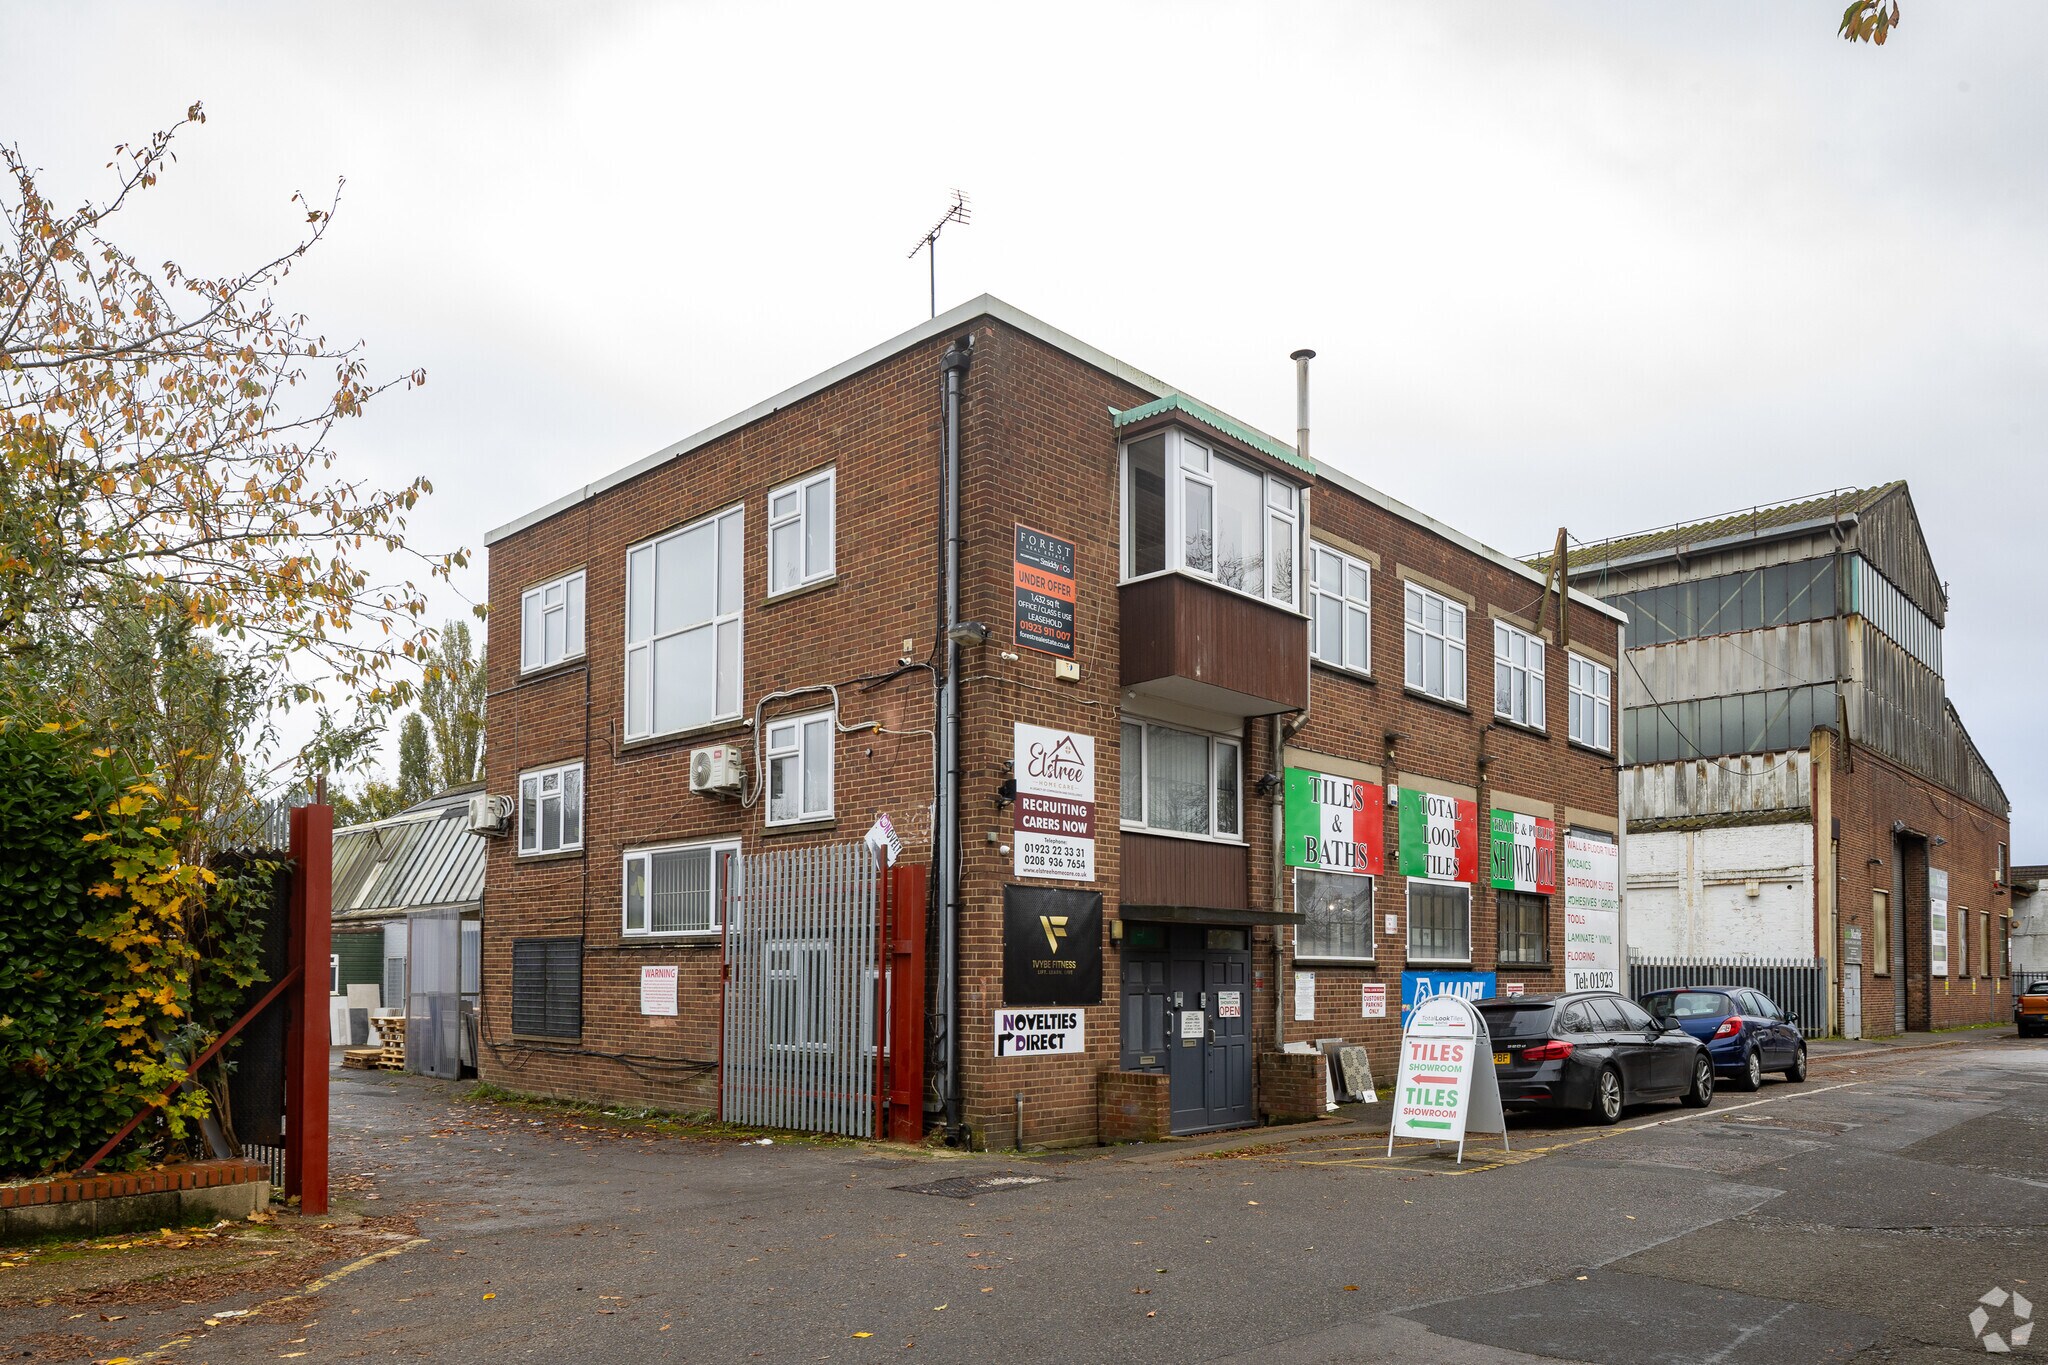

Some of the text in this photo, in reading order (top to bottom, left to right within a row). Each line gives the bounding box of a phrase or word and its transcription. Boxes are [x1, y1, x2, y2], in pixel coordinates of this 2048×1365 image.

[1020, 531, 1071, 557] FOREST
[1025, 544, 1041, 553] REAL
[1044, 551, 1065, 561] ESTATE
[1018, 570, 1072, 597] UNDER OFFER
[1017, 600, 1038, 612] OFFICE
[1040, 606, 1058, 617] CLASS
[1057, 611, 1062, 619] E
[1061, 612, 1073, 622] USE
[1046, 599, 1055, 609] sq
[1027, 612, 1063, 628] LEASEHOLD
[1019, 630, 1071, 650] forestrealestate.co.uk
[1020, 620, 1072, 642] 01923 911 007
[1028, 742, 1084, 782] Elstree
[1038, 780, 1075, 791] HOME CARE
[1307, 776, 1364, 811] TILES
[1022, 797, 1087, 818] RECRUITING
[1419, 794, 1462, 822] TOTAL
[1022, 815, 1088, 834] CARERS NOW
[1331, 814, 1342, 833] &
[1493, 817, 1554, 841] TRADE & PUBLIC
[1422, 824, 1460, 849] LOOK
[1024, 843, 1085, 858] 01923 22 33 31
[1304, 835, 1369, 870] BATHS
[1567, 839, 1582, 851] WALL
[1587, 843, 1604, 854] FLOOR
[1604, 845, 1618, 857] TILES
[1024, 855, 1086, 869] 0208 936 7654
[1423, 854, 1460, 880] TILES
[1492, 839, 1555, 887] SHOWROOM
[1566, 858, 1592, 870] MOSAICS
[1022, 868, 1088, 878] www.elstreehomecare.co.uk
[1566, 876, 1614, 891] BATHROOM SUITES
[1567, 895, 1619, 909] ADHESIVES GROUTS
[1567, 914, 1586, 925] TOOLS
[1567, 932, 1613, 945] LAMINATE VINYL
[1052, 959, 1077, 969] FITNESS
[1567, 951, 1596, 962] FLOORING
[644, 969, 676, 979] WARNING
[1573, 971, 1614, 990] Tel: 01923
[1219, 1006, 1241, 1016] OPEN
[1003, 1012, 1077, 1031] NOVELTIES
[1015, 1033, 1066, 1052] DIRECT
[1411, 1043, 1464, 1063] TILES
[1408, 1063, 1462, 1073] SHOWROOM
[1405, 1087, 1459, 1108] TILES
[1403, 1107, 1457, 1118] SHOWROOM
